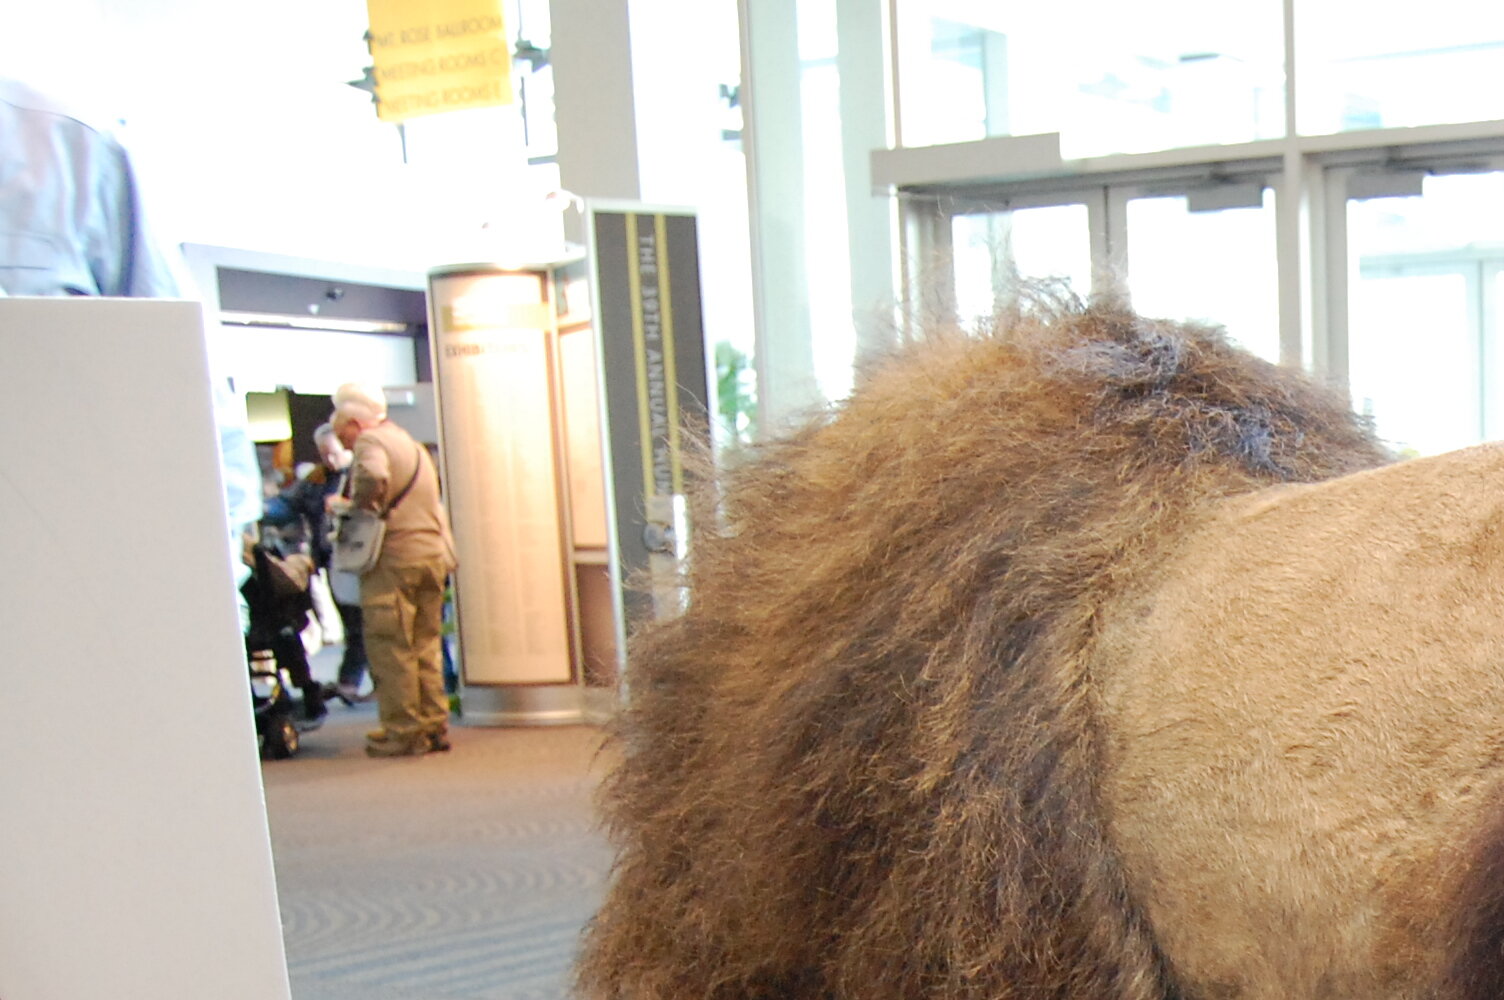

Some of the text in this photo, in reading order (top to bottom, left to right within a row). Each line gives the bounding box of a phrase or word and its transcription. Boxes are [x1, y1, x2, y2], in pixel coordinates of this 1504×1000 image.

[436, 15, 502, 39] BALLROOM
[381, 58, 437, 79] MEETING
[439, 51, 486, 71] ROOMS
[442, 83, 489, 104] ROOMS
[638, 236, 658, 275] THE
[646, 347, 668, 439] ANNUAL
